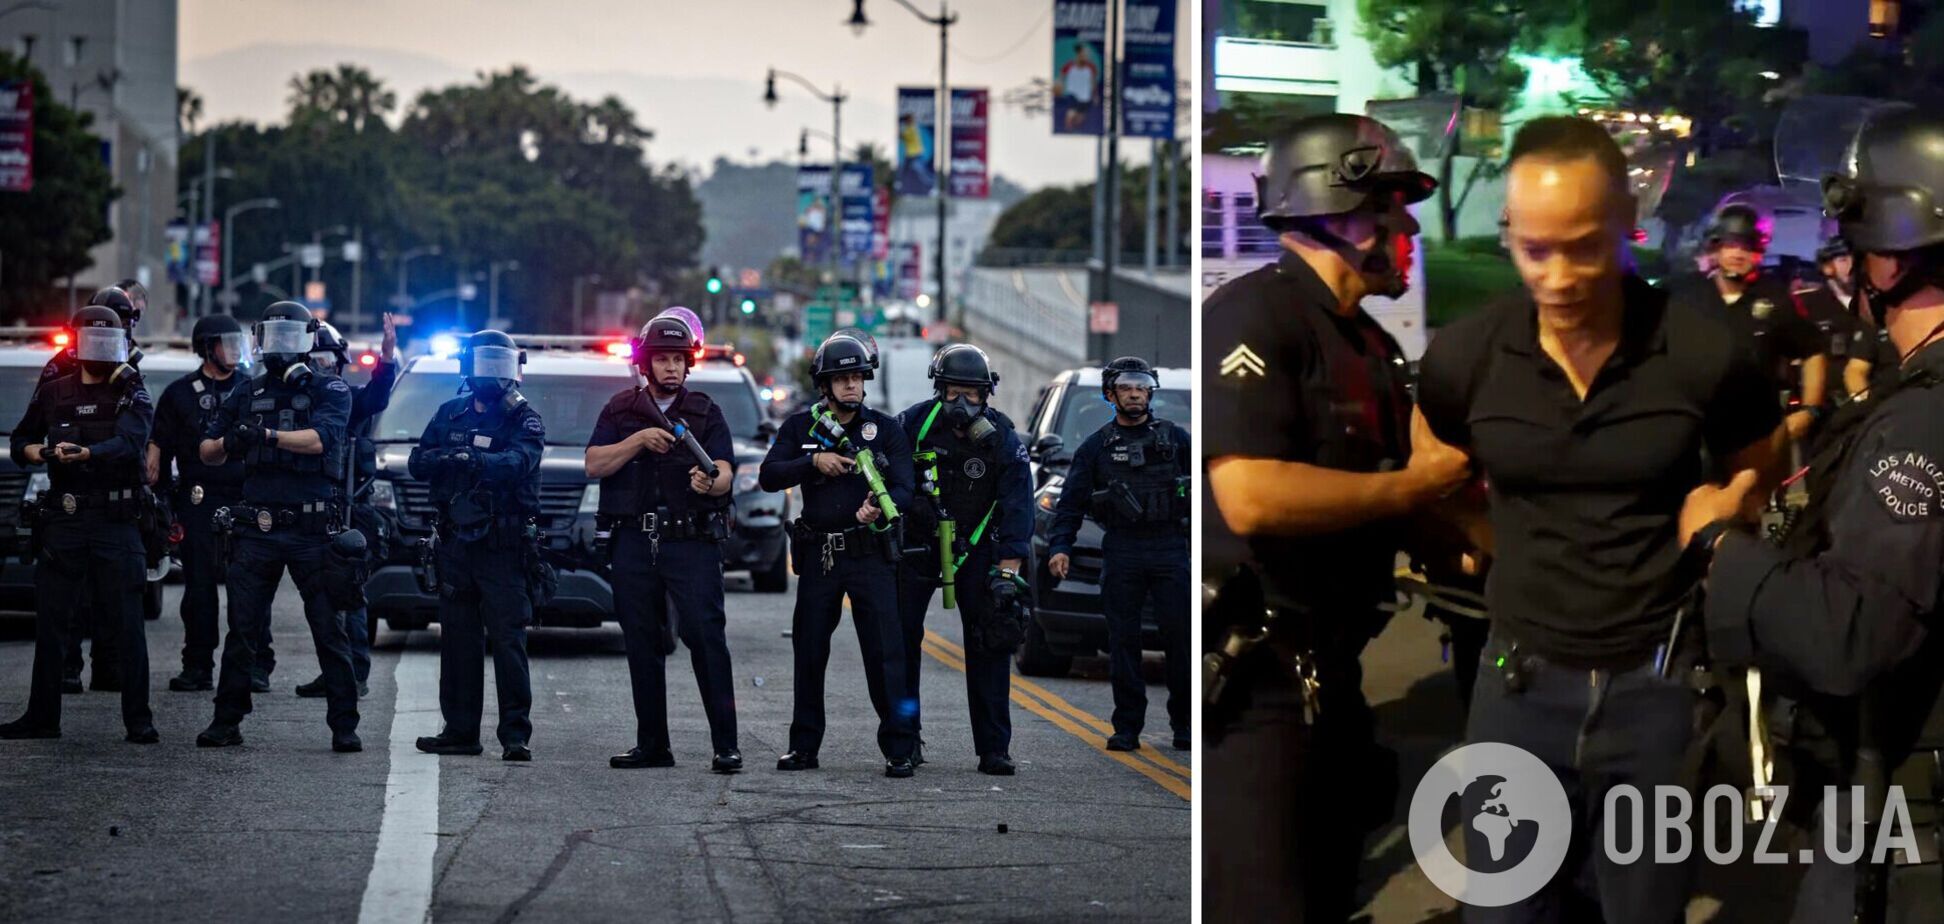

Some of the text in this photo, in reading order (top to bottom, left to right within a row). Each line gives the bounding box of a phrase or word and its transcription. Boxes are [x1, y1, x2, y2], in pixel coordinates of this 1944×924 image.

[839, 357, 856, 365] ROBLES
[1869, 455, 1900, 478] LOS
[1888, 470, 1934, 498] METRO
[1878, 485, 1929, 516] POLICE
